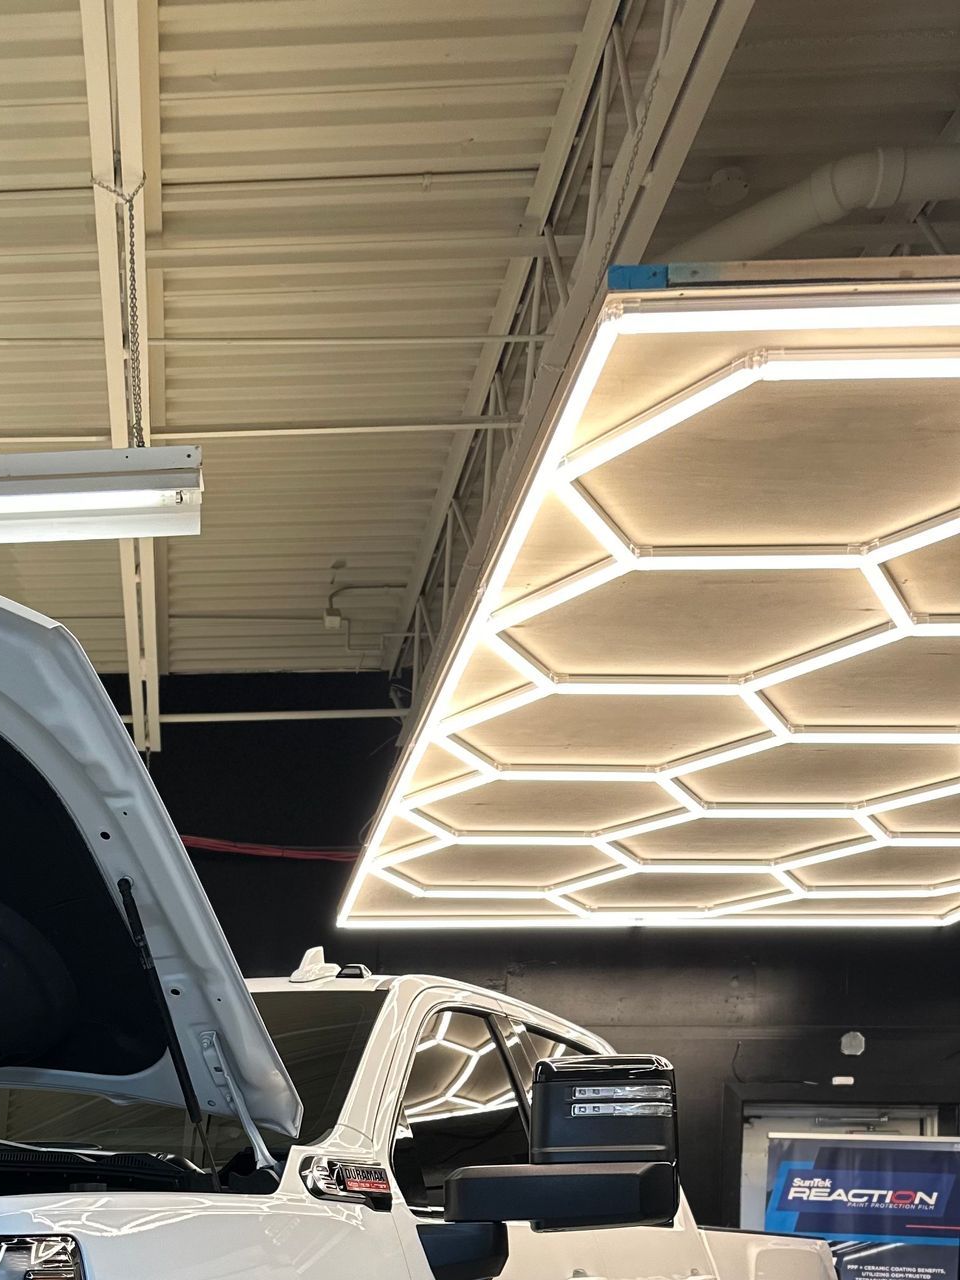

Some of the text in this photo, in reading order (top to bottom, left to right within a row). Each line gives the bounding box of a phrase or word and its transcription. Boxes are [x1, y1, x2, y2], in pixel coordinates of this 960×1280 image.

[345, 1168, 385, 1181] DURAMAX
[792, 1177, 832, 1188] SunTek
[788, 1187, 938, 1205] REACTION
